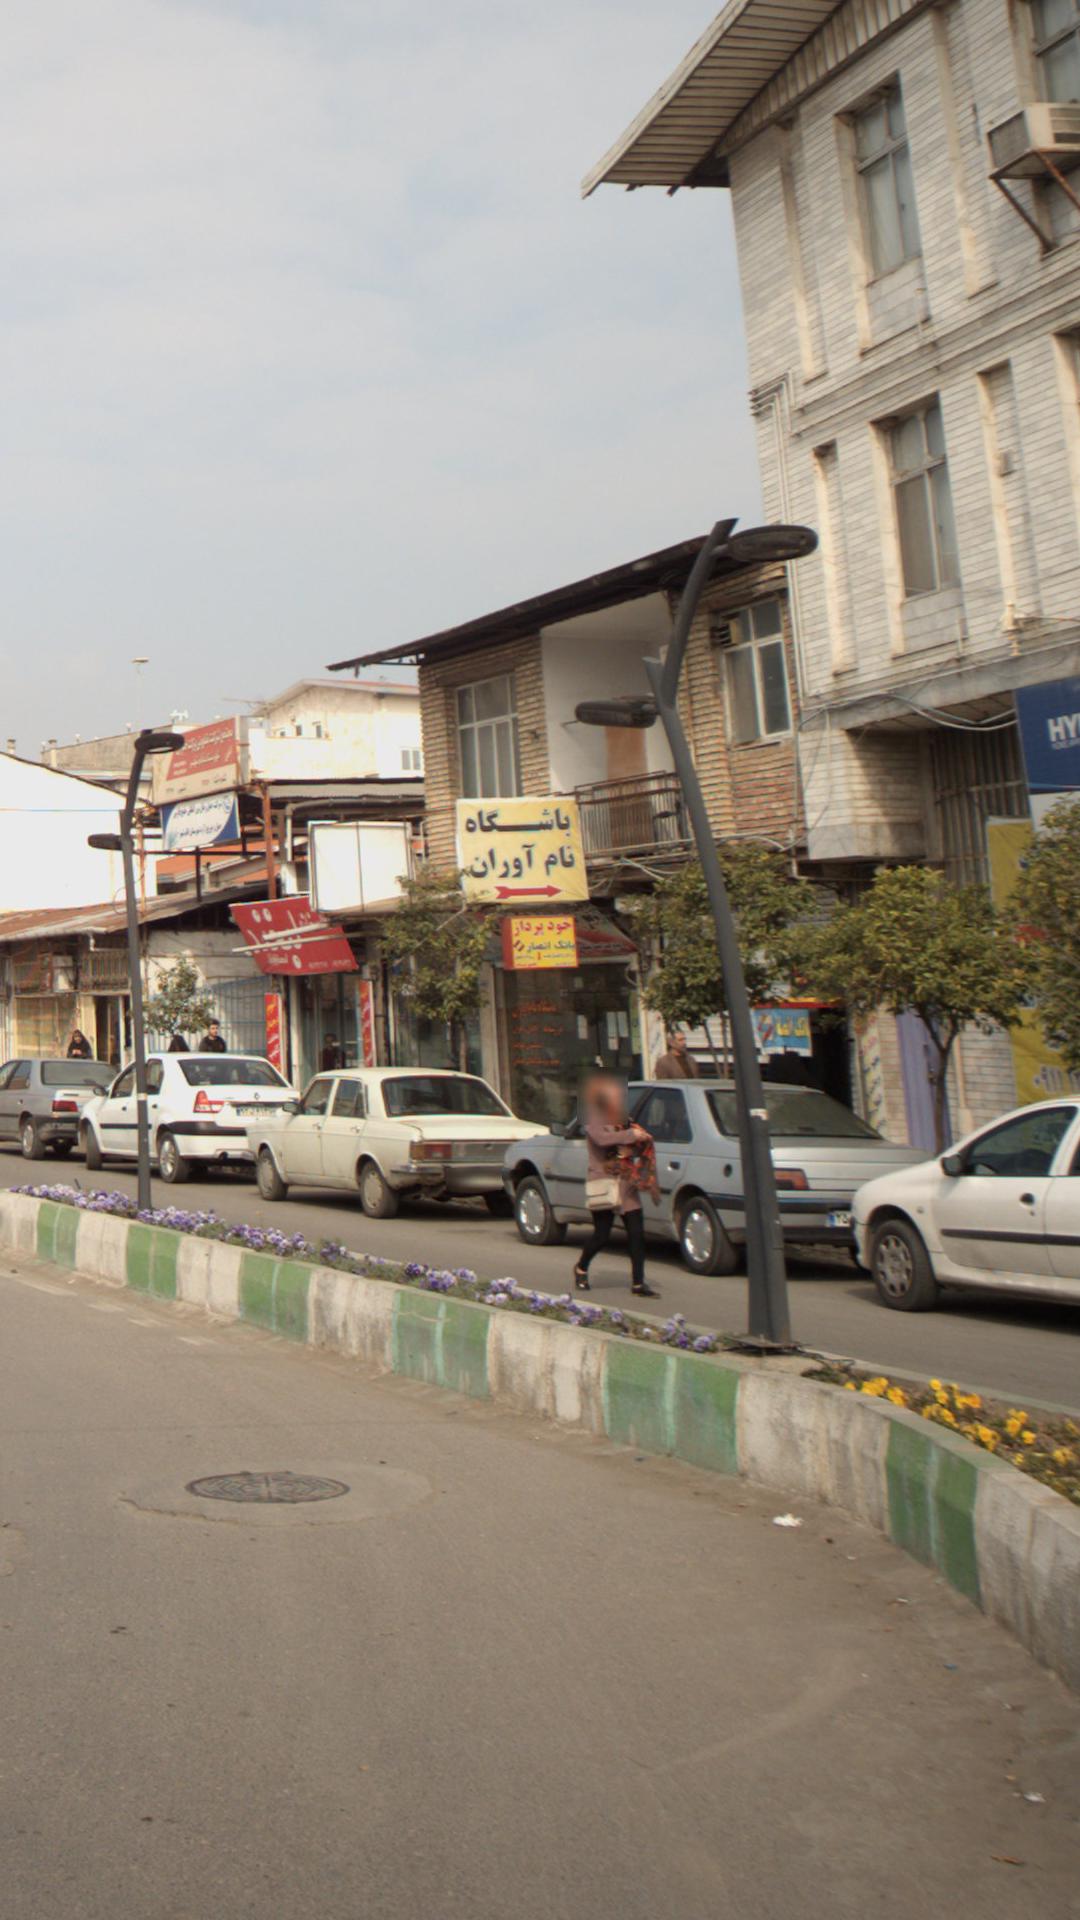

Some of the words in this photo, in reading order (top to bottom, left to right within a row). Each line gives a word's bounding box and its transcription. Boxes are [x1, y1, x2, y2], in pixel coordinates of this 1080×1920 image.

[465, 808, 570, 836] باشگاه
[470, 843, 535, 878] آوران
[544, 845, 575, 876] نام
